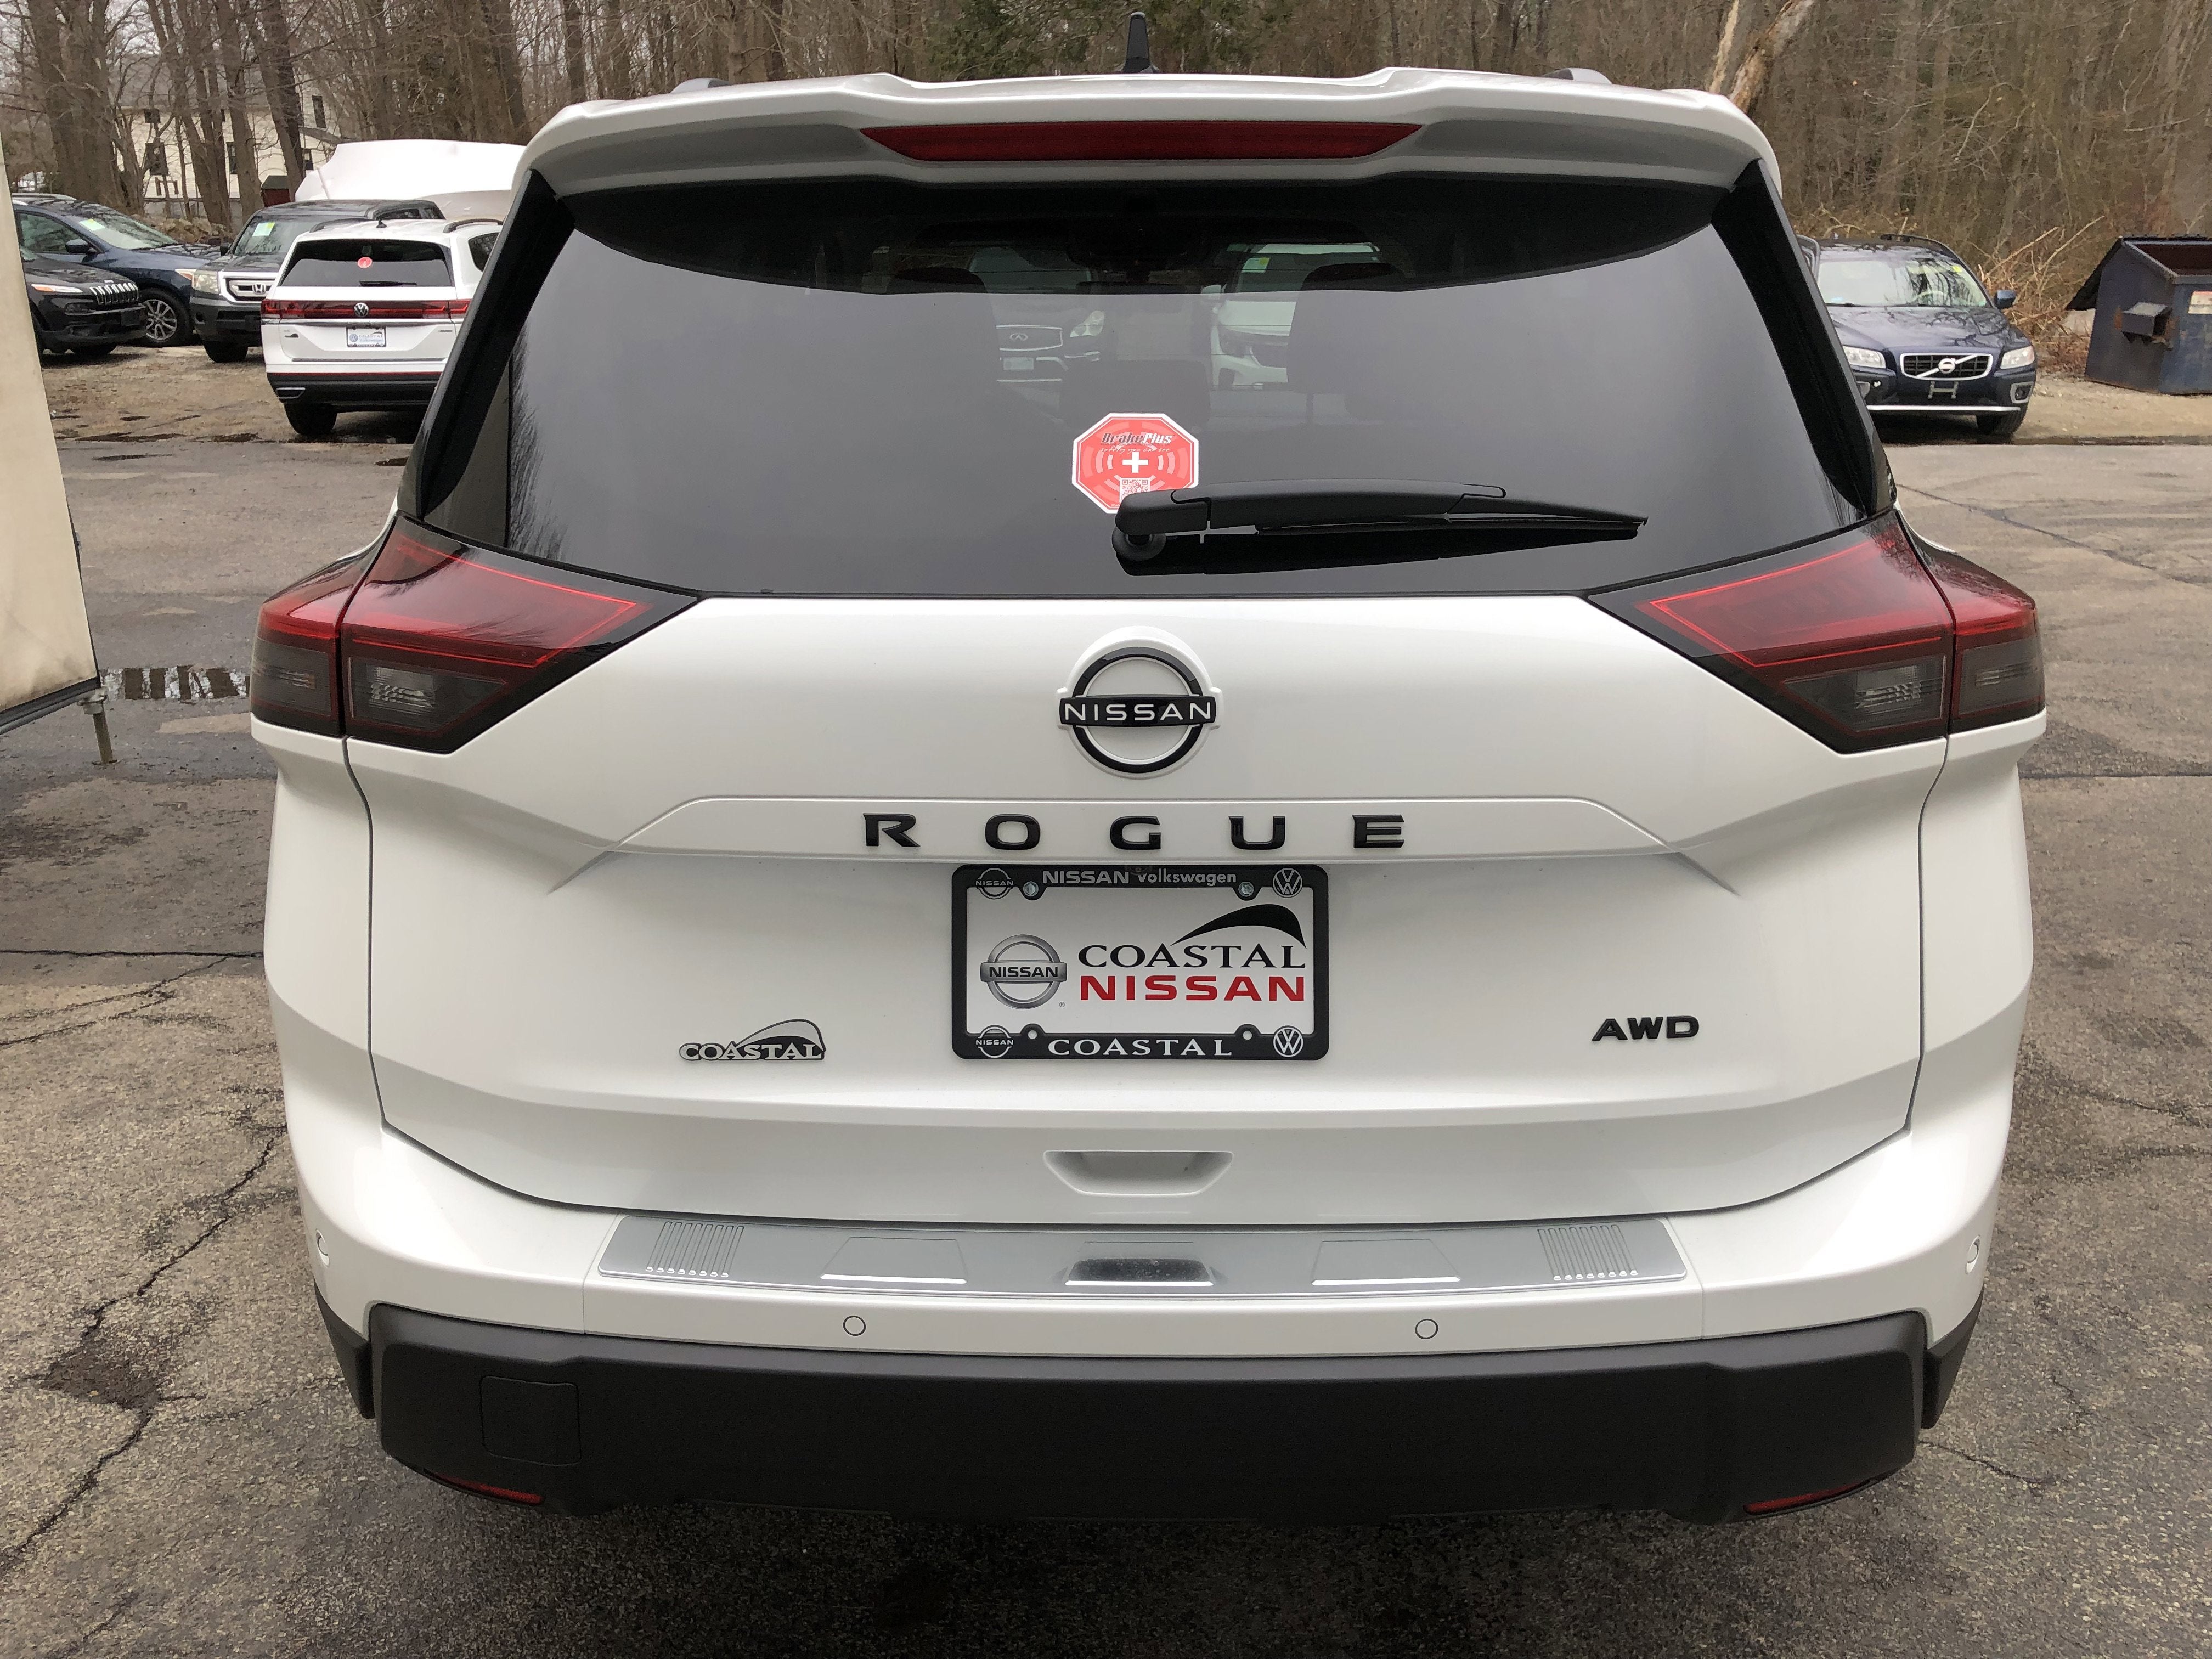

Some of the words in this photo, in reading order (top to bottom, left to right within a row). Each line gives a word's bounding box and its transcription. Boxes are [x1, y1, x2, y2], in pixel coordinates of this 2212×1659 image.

[1102, 433, 1172, 444] BrakePlus
[1064, 702, 1211, 721] NISSAN
[862, 812, 1406, 851] ROGUE
[1042, 871, 1129, 884] NISSAN
[1137, 869, 1237, 887] volkswagen
[1078, 943, 1306, 968] COASTAL
[989, 966, 1059, 978] NISSAN
[1080, 975, 1305, 1001] NISSAN
[1592, 1015, 1700, 1041] AWD
[680, 1042, 822, 1060] COASTAL
[1048, 1039, 1232, 1057] COASTAL
